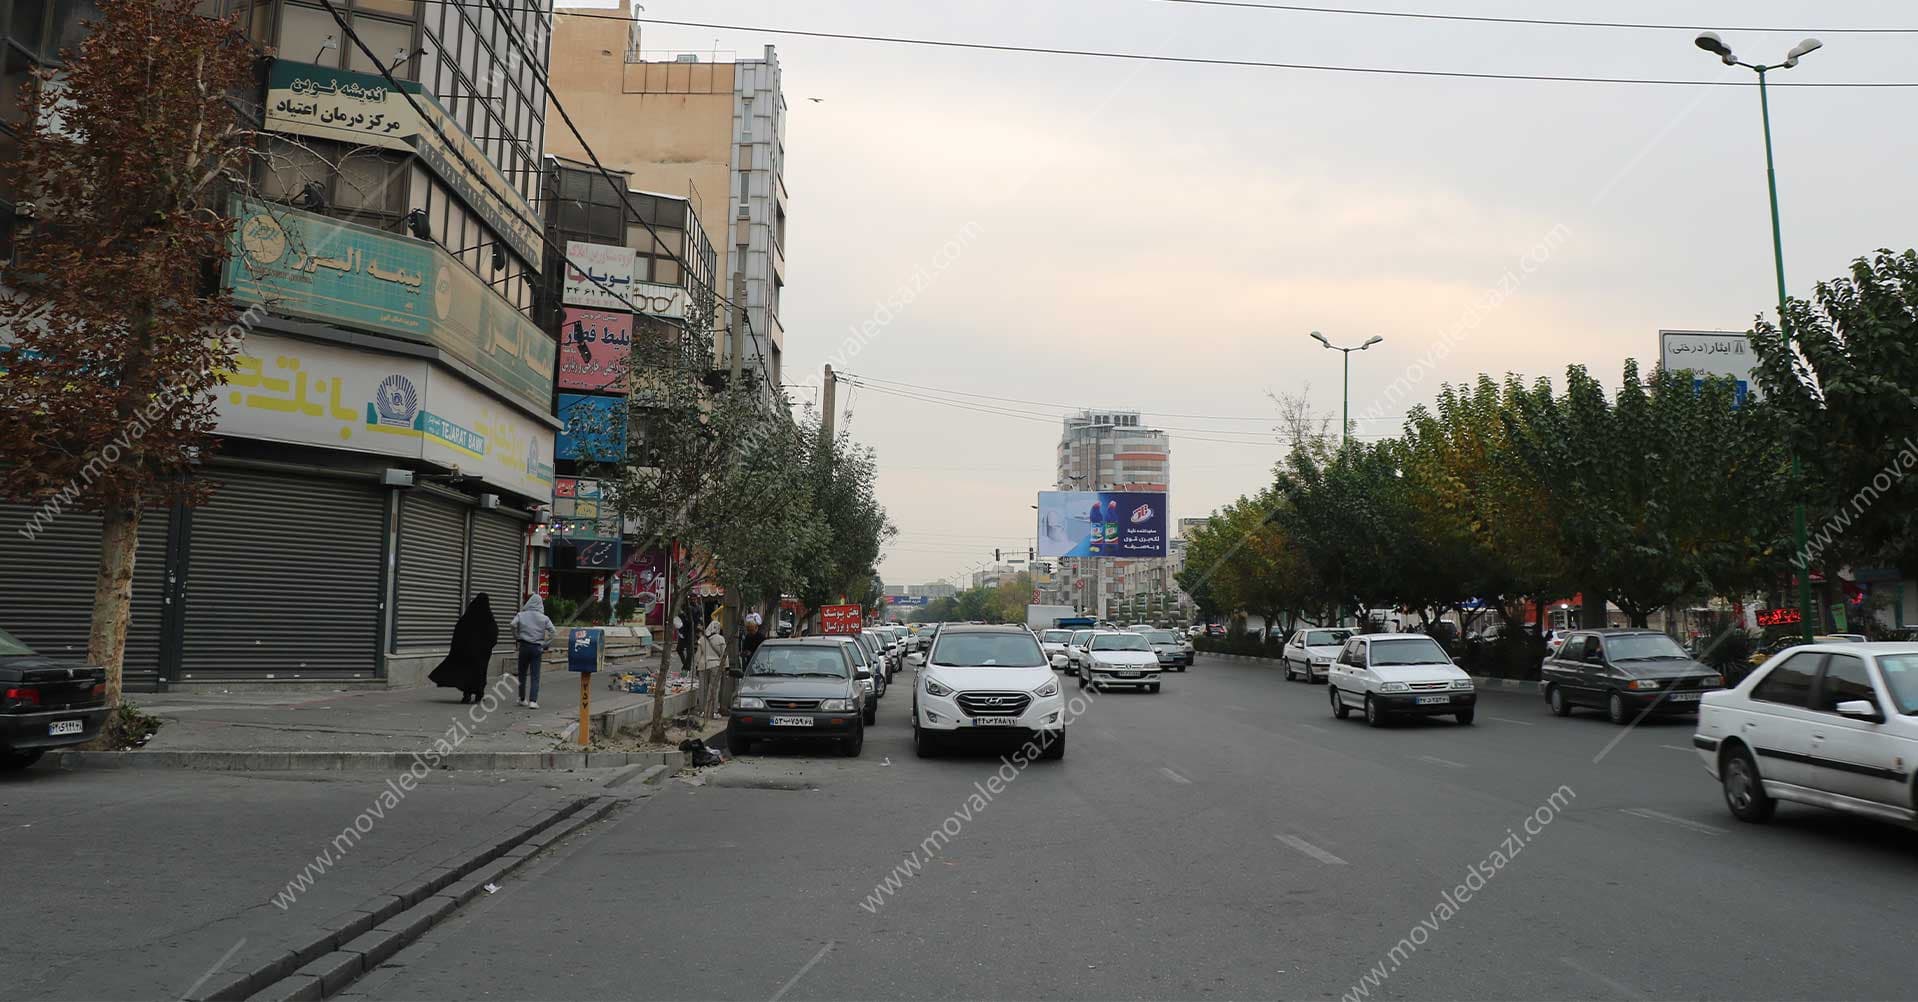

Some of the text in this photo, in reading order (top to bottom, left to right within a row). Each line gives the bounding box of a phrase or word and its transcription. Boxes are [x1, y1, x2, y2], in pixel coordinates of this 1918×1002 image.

[290, 78, 388, 103] اندیشه نوین
[276, 98, 401, 133] مرکز درمان اعتیاد
[291, 246, 362, 279] البرز
[366, 258, 424, 295] بیمه
[601, 325, 630, 351] بلیط
[441, 421, 467, 447] TEJARAT
[468, 432, 484, 454] BANK
[591, 541, 613, 565] مجتمع
[824, 620, 845, 633] بزرگسال
